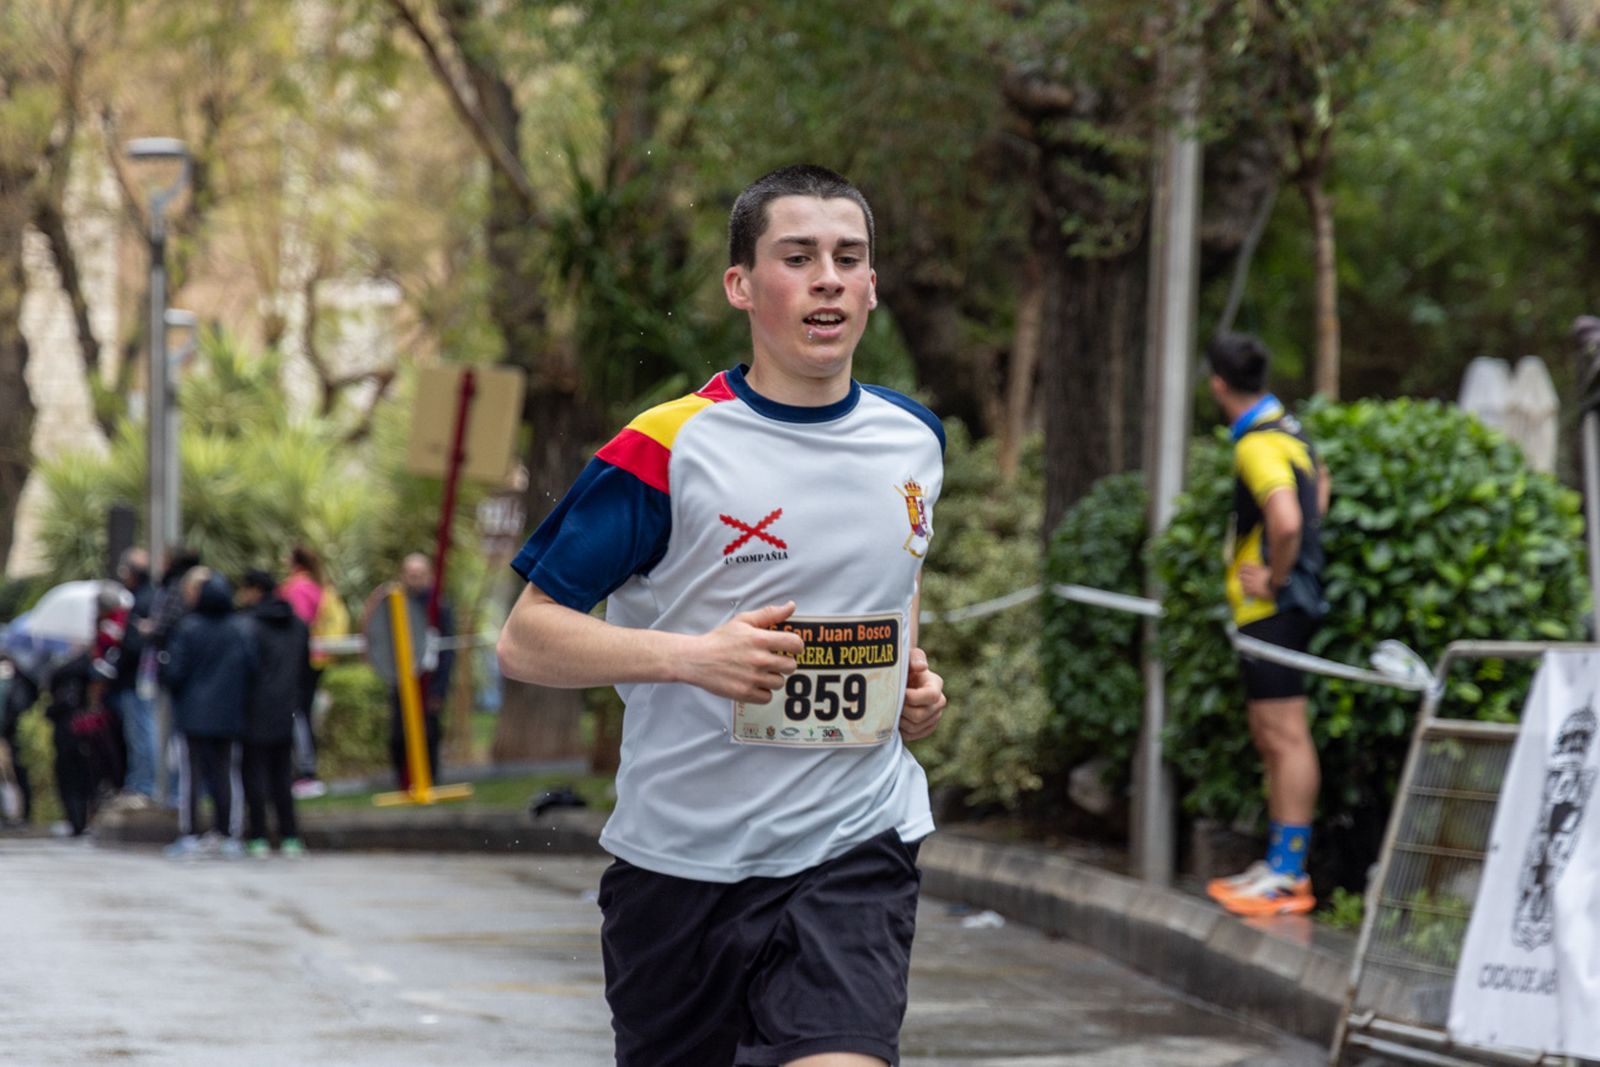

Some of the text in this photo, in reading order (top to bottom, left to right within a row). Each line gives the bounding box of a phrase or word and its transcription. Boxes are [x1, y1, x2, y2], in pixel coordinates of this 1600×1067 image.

[817, 625, 853, 642] Juan
[857, 624, 891, 641] Bosco
[839, 643, 894, 665] POPULAR
[784, 673, 867, 722] 859
